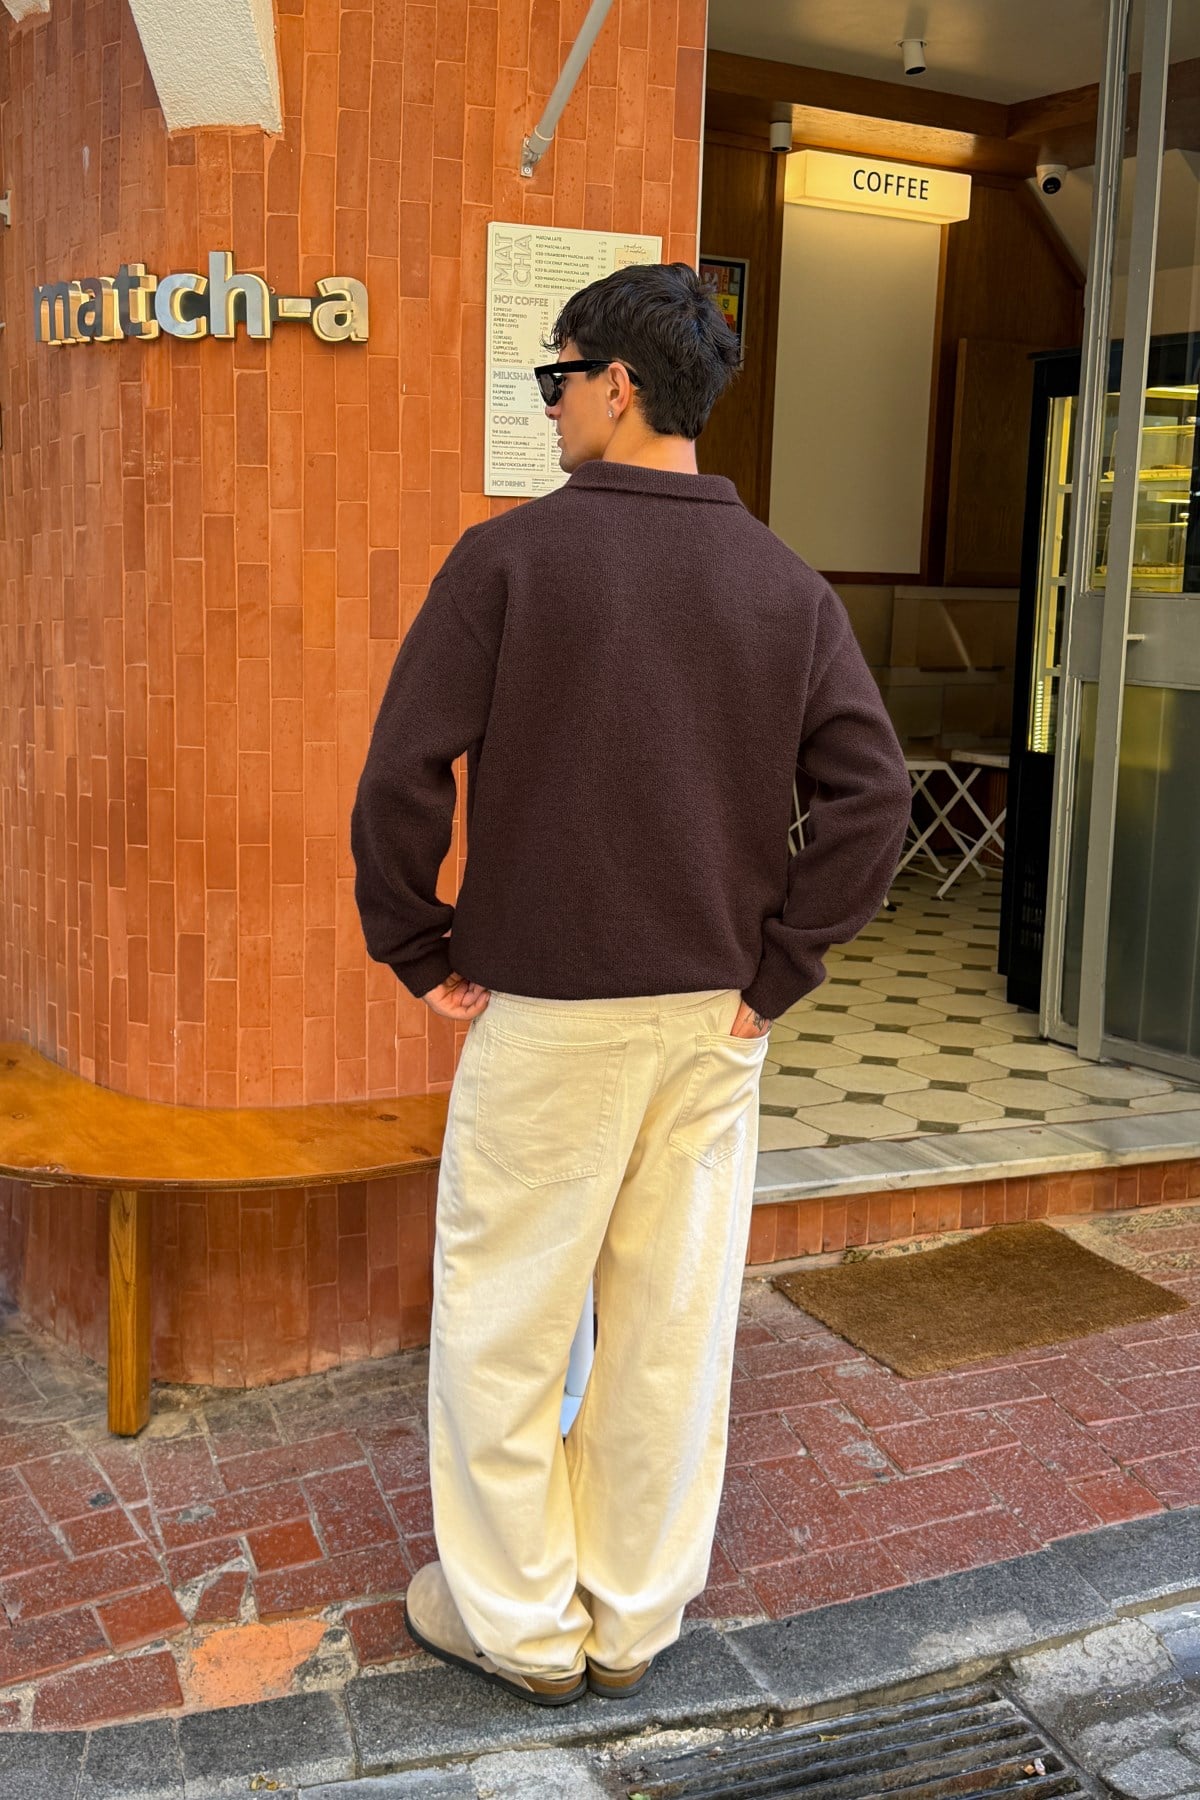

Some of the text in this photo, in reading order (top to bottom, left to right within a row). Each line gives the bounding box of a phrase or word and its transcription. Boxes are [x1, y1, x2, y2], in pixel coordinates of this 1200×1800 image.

[853, 170, 929, 200] COFFEE
[33, 250, 369, 346] match-a
[494, 295, 513, 304] HOT
[515, 296, 549, 307] COFFEE
[493, 371, 535, 381] MILKSHAK
[493, 415, 529, 426] COOKIE
